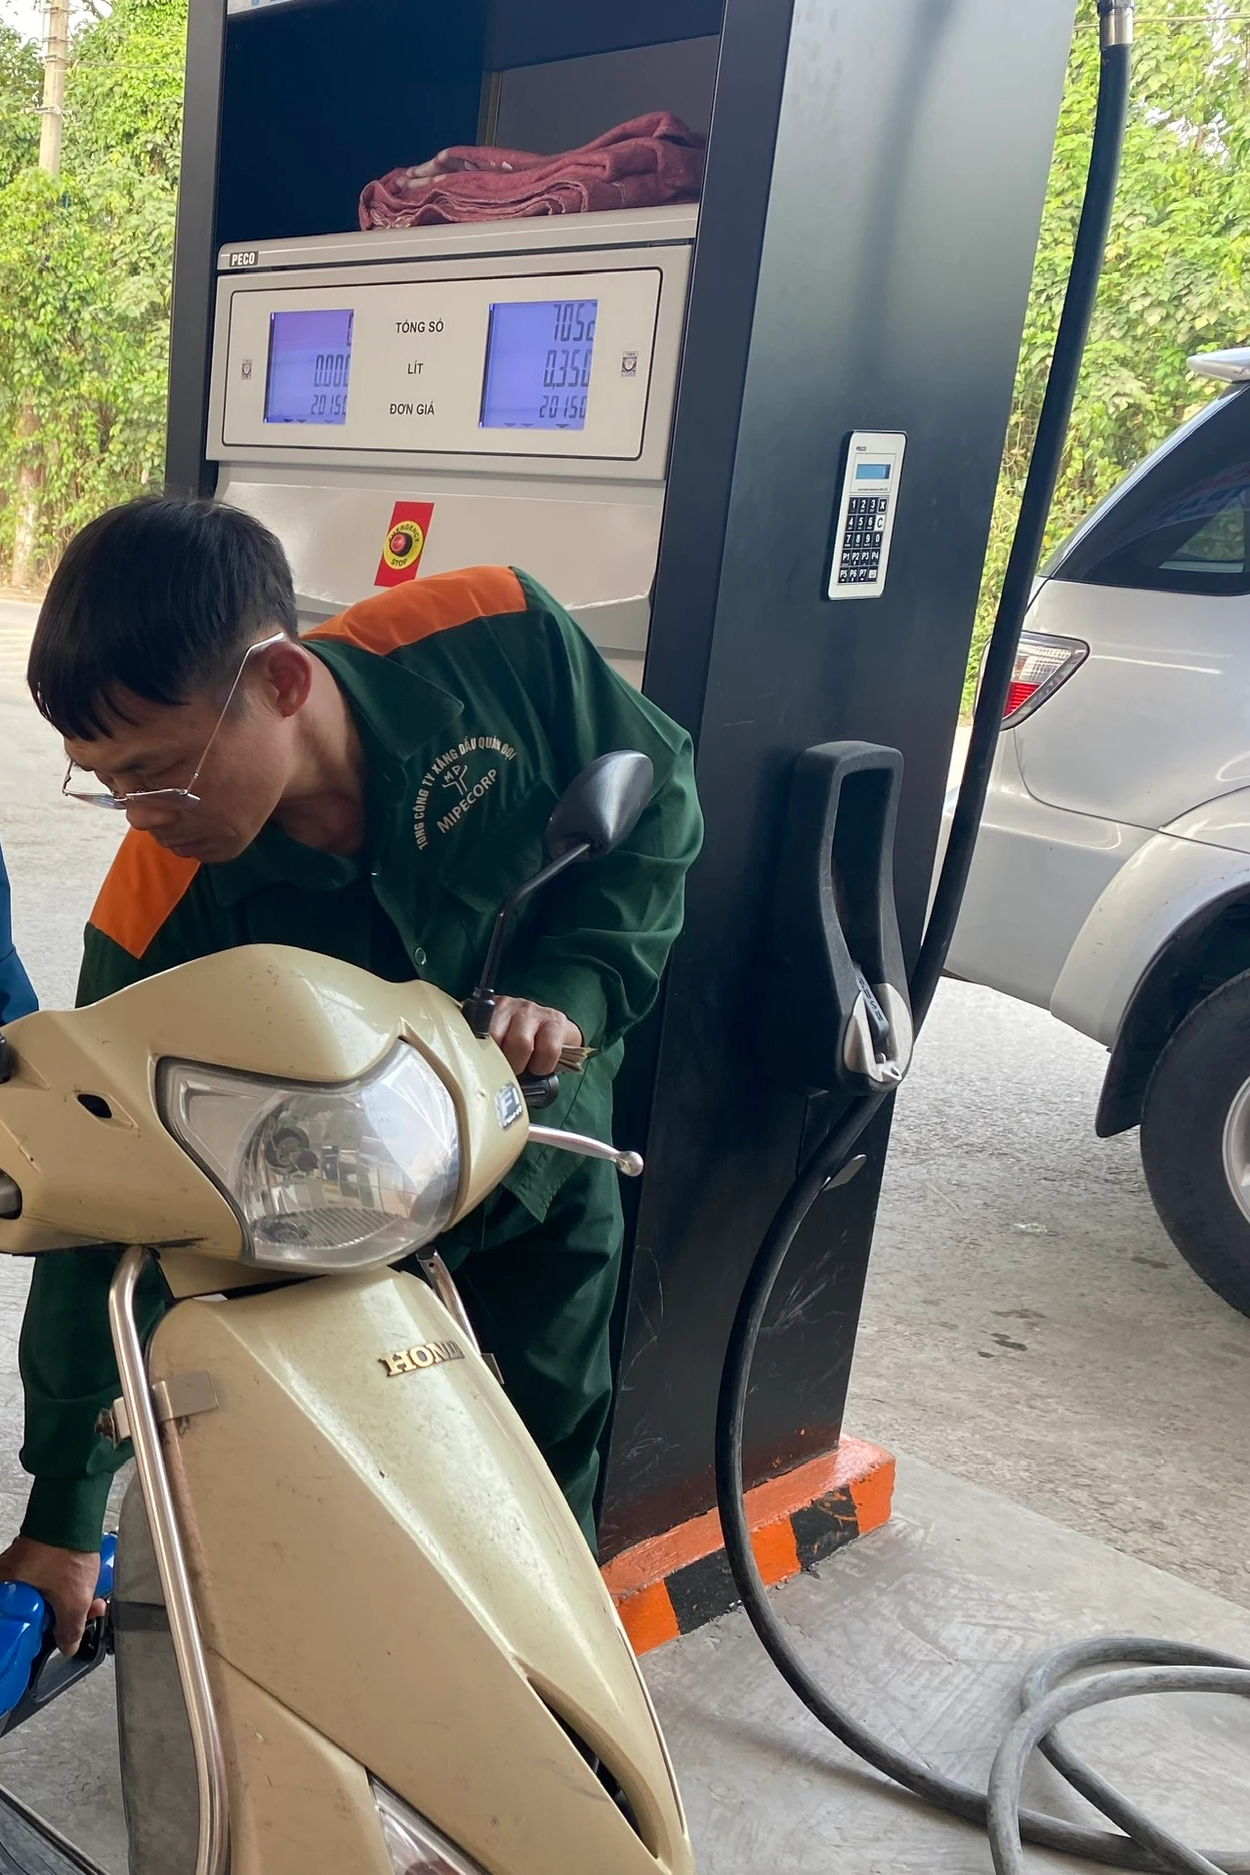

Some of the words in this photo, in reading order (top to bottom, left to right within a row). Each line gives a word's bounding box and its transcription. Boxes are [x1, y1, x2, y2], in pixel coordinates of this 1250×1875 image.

[231, 252, 256, 266] PECO
[407, 359, 424, 375] LÍT
[389, 403, 414, 415] ĐƠN
[416, 400, 435, 415] GIÁ
[538, 395, 588, 418] 20150
[861, 499, 866, 508] 2
[871, 499, 876, 508] 3
[849, 517, 854, 526] 4
[858, 517, 863, 526] 5
[868, 517, 873, 526] 6
[877, 517, 883, 528] C
[846, 534, 851, 543] 7
[855, 534, 861, 543] 8
[865, 534, 870, 543] 9
[843, 552, 850, 561] P1
[852, 552, 860, 560] P2
[861, 552, 869, 560] P3
[871, 551, 879, 560] P4
[391, 558, 408, 567] STOP
[840, 569, 848, 578] P5
[849, 569, 857, 578] P6
[859, 569, 867, 577] P7
[421, 772, 436, 787] TY
[436, 768, 498, 834] MIPECORP
